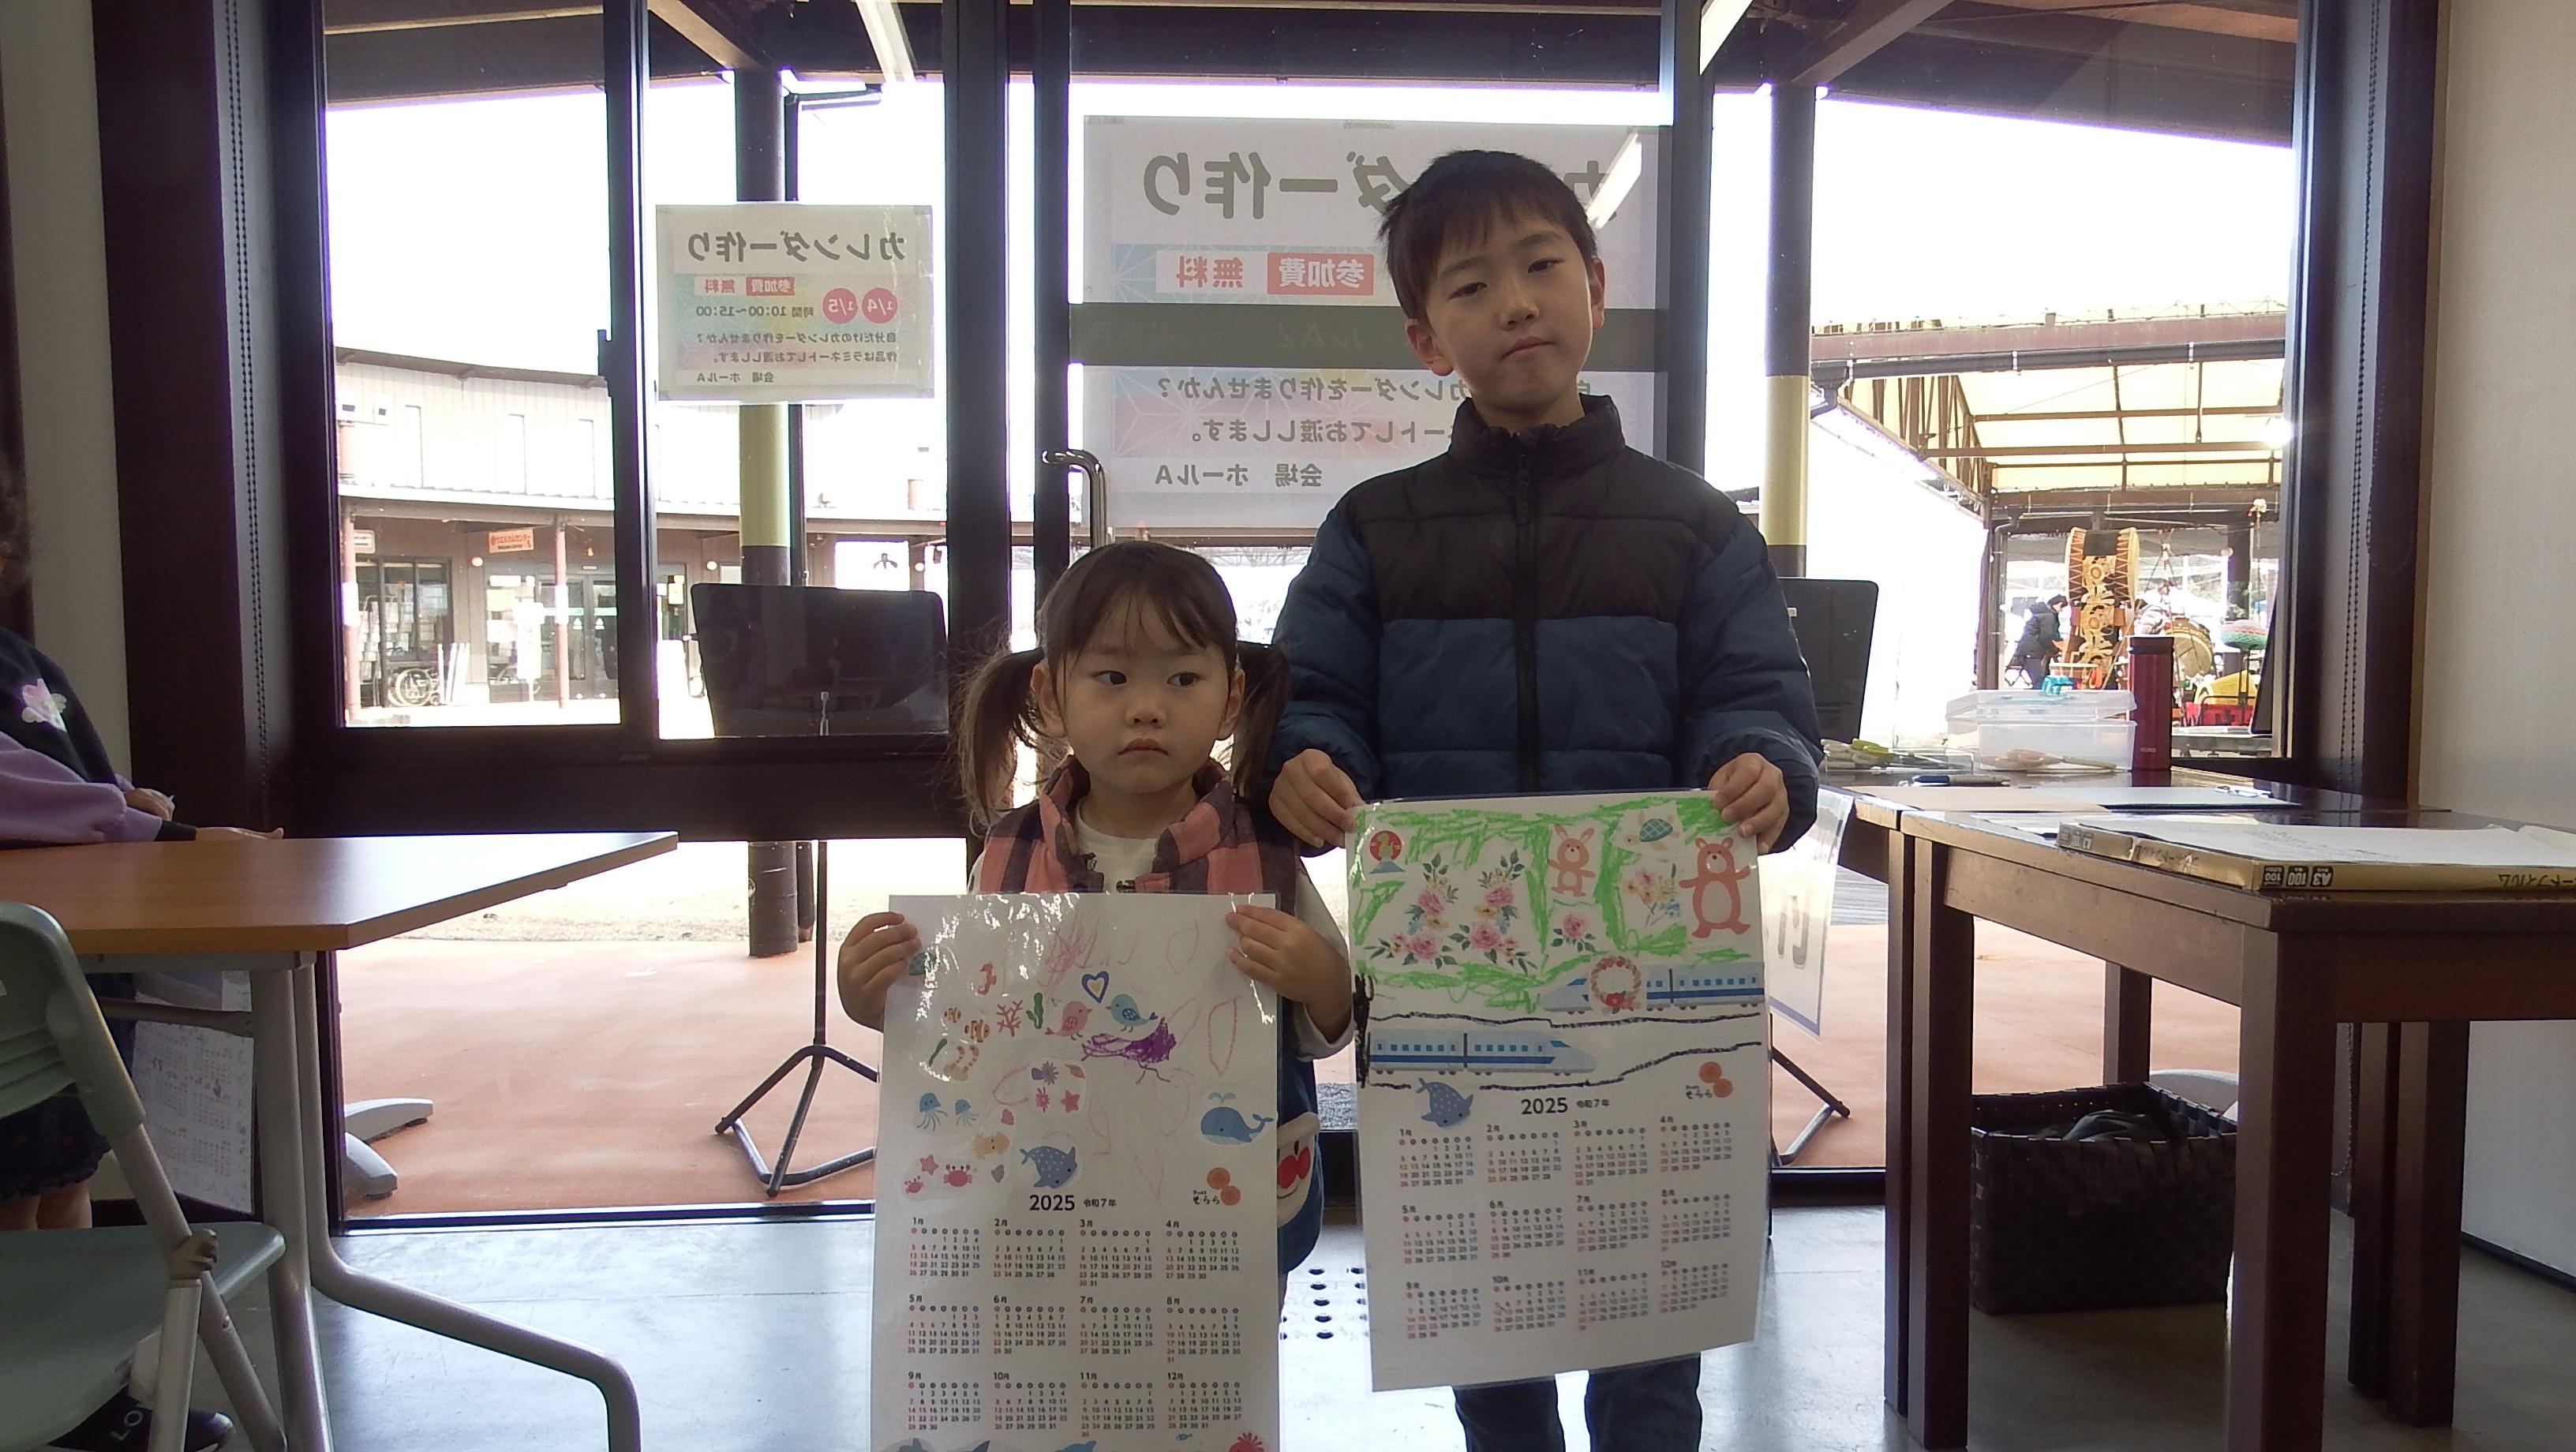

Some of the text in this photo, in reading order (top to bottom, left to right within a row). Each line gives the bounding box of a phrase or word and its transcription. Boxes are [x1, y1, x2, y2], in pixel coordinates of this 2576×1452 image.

[2288, 873, 2306, 885] 100
[2313, 873, 2332, 885] A3
[2498, 874, 2576, 887] ートフィルム
[1522, 1097, 1568, 1114] 2025
[1029, 1194, 1117, 1211] 2025 令和7年
[909, 1294, 923, 1303] 5月
[994, 1294, 1007, 1303] 6月
[1166, 1297, 1180, 1305] 8月
[993, 1372, 1009, 1380] 10月
[1080, 1372, 1097, 1380] 11月
[1167, 1372, 1184, 1380] 12月
